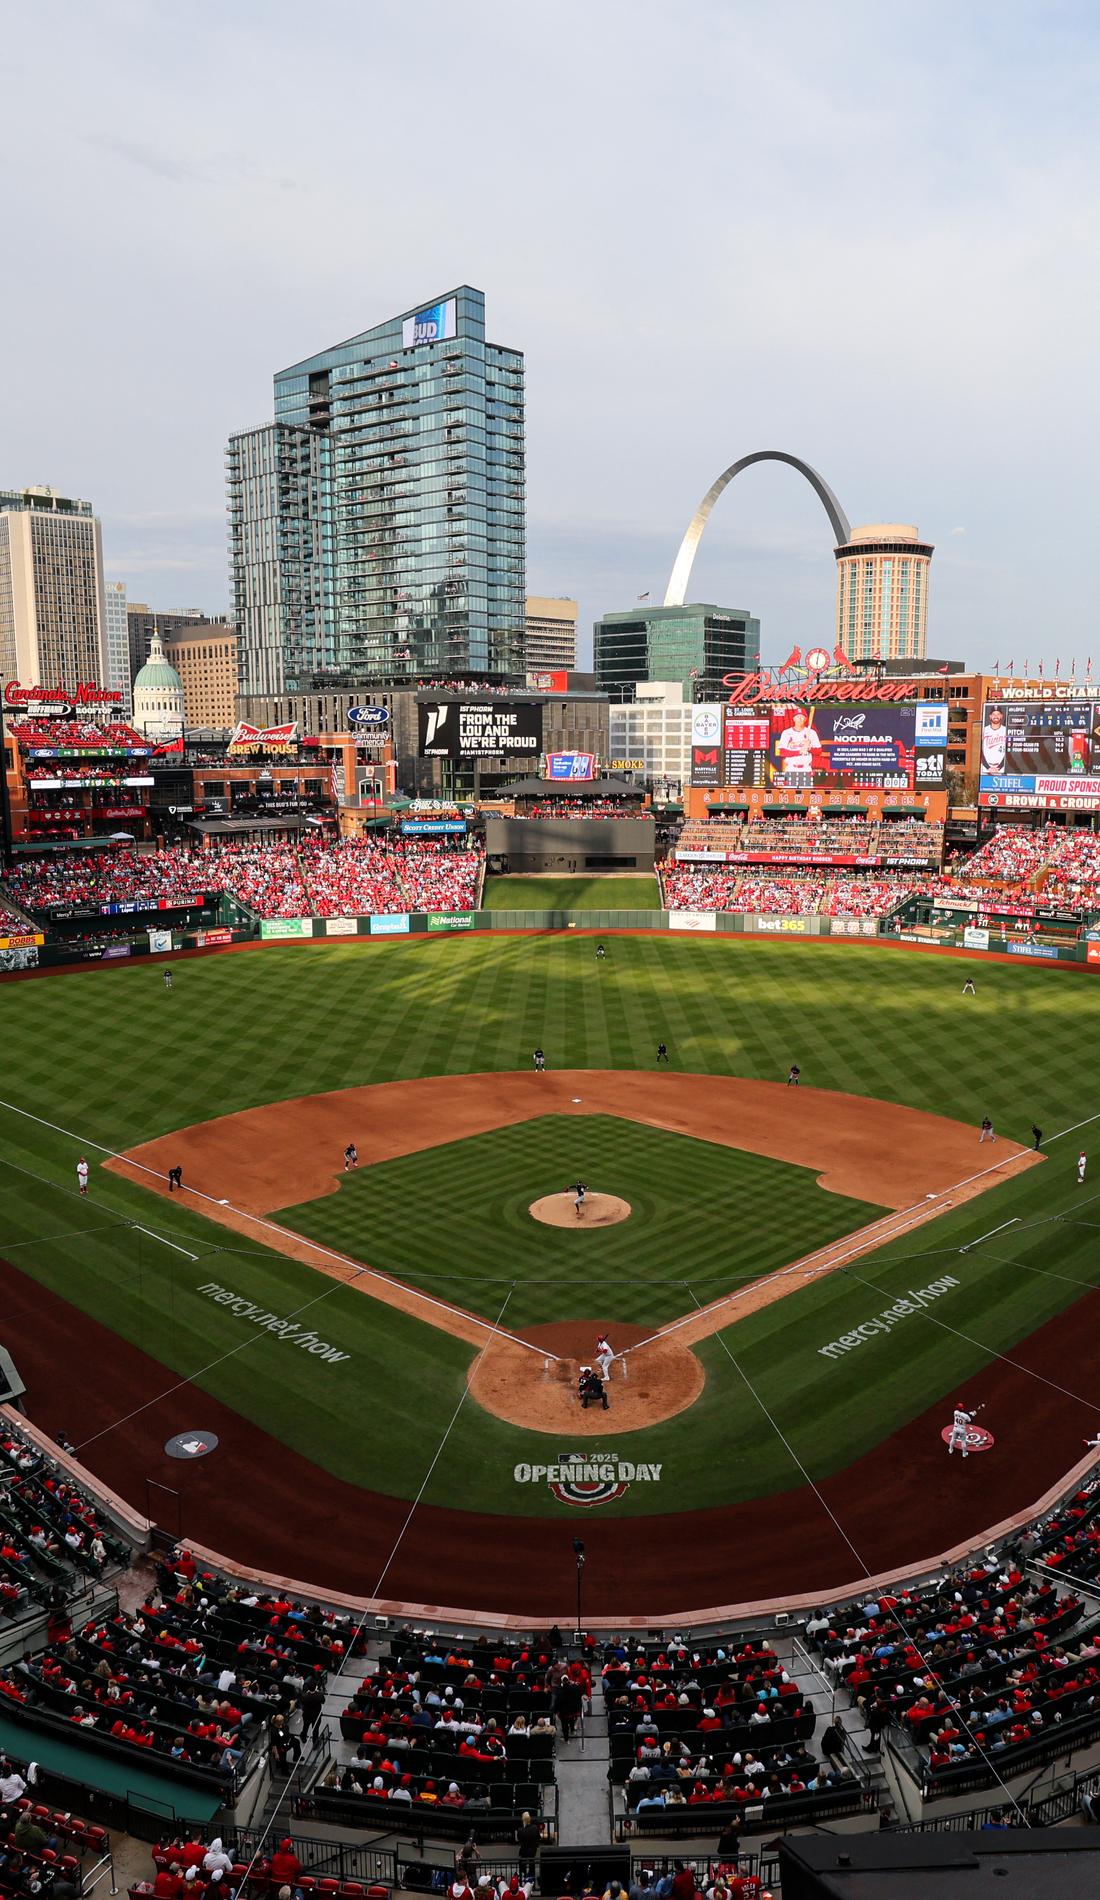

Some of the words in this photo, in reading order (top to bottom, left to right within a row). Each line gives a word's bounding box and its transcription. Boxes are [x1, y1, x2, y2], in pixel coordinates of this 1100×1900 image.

[414, 322, 437, 338] BUD
[5, 681, 68, 704] Cardinals
[70, 682, 123, 704] Nation
[722, 672, 916, 705] Budweiser
[1002, 688, 1052, 698] WORLD
[28, 705, 64, 714] HOFFMANN
[357, 708, 381, 720] Ford
[460, 714, 492, 725] FROM
[495, 714, 517, 725] THE
[229, 729, 297, 742] Budweiser
[352, 732, 389, 740] Community
[460, 726, 482, 736] LOU
[484, 726, 509, 736] AND
[460, 737, 496, 748] WE'RE
[500, 737, 536, 748] PROUD
[230, 744, 260, 754] BREW
[263, 744, 298, 754] HOUSE
[612, 760, 644, 768] SMOKE
[916, 754, 944, 770] stl
[993, 777, 1023, 788] STIFEL
[1038, 780, 1066, 791] PROUD
[720, 793, 724, 802] 1
[728, 794, 736, 802] 2
[752, 794, 758, 803] 9
[764, 794, 773, 804] 10
[779, 794, 788, 804] 14
[794, 794, 804, 804] 17
[810, 794, 822, 804] 20
[865, 795, 878, 805] 42
[884, 796, 897, 806] 45
[902, 796, 914, 806] 85
[1006, 796, 1046, 806] BROWN
[1050, 799, 1056, 807] &
[728, 853, 748, 861] Coca-Cola
[856, 856, 878, 864] Coca-Cola
[440, 916, 472, 926] National
[758, 918, 804, 931] bet365
[9, 936, 36, 945] DOBBS
[1012, 945, 1032, 953] STIFEL
[817, 1274, 960, 1359] mercy.net/now
[196, 1282, 351, 1363] mercy.net/now
[590, 1454, 619, 1462] 2025
[514, 1463, 614, 1482] OPENING
[619, 1462, 662, 1482] DAY
